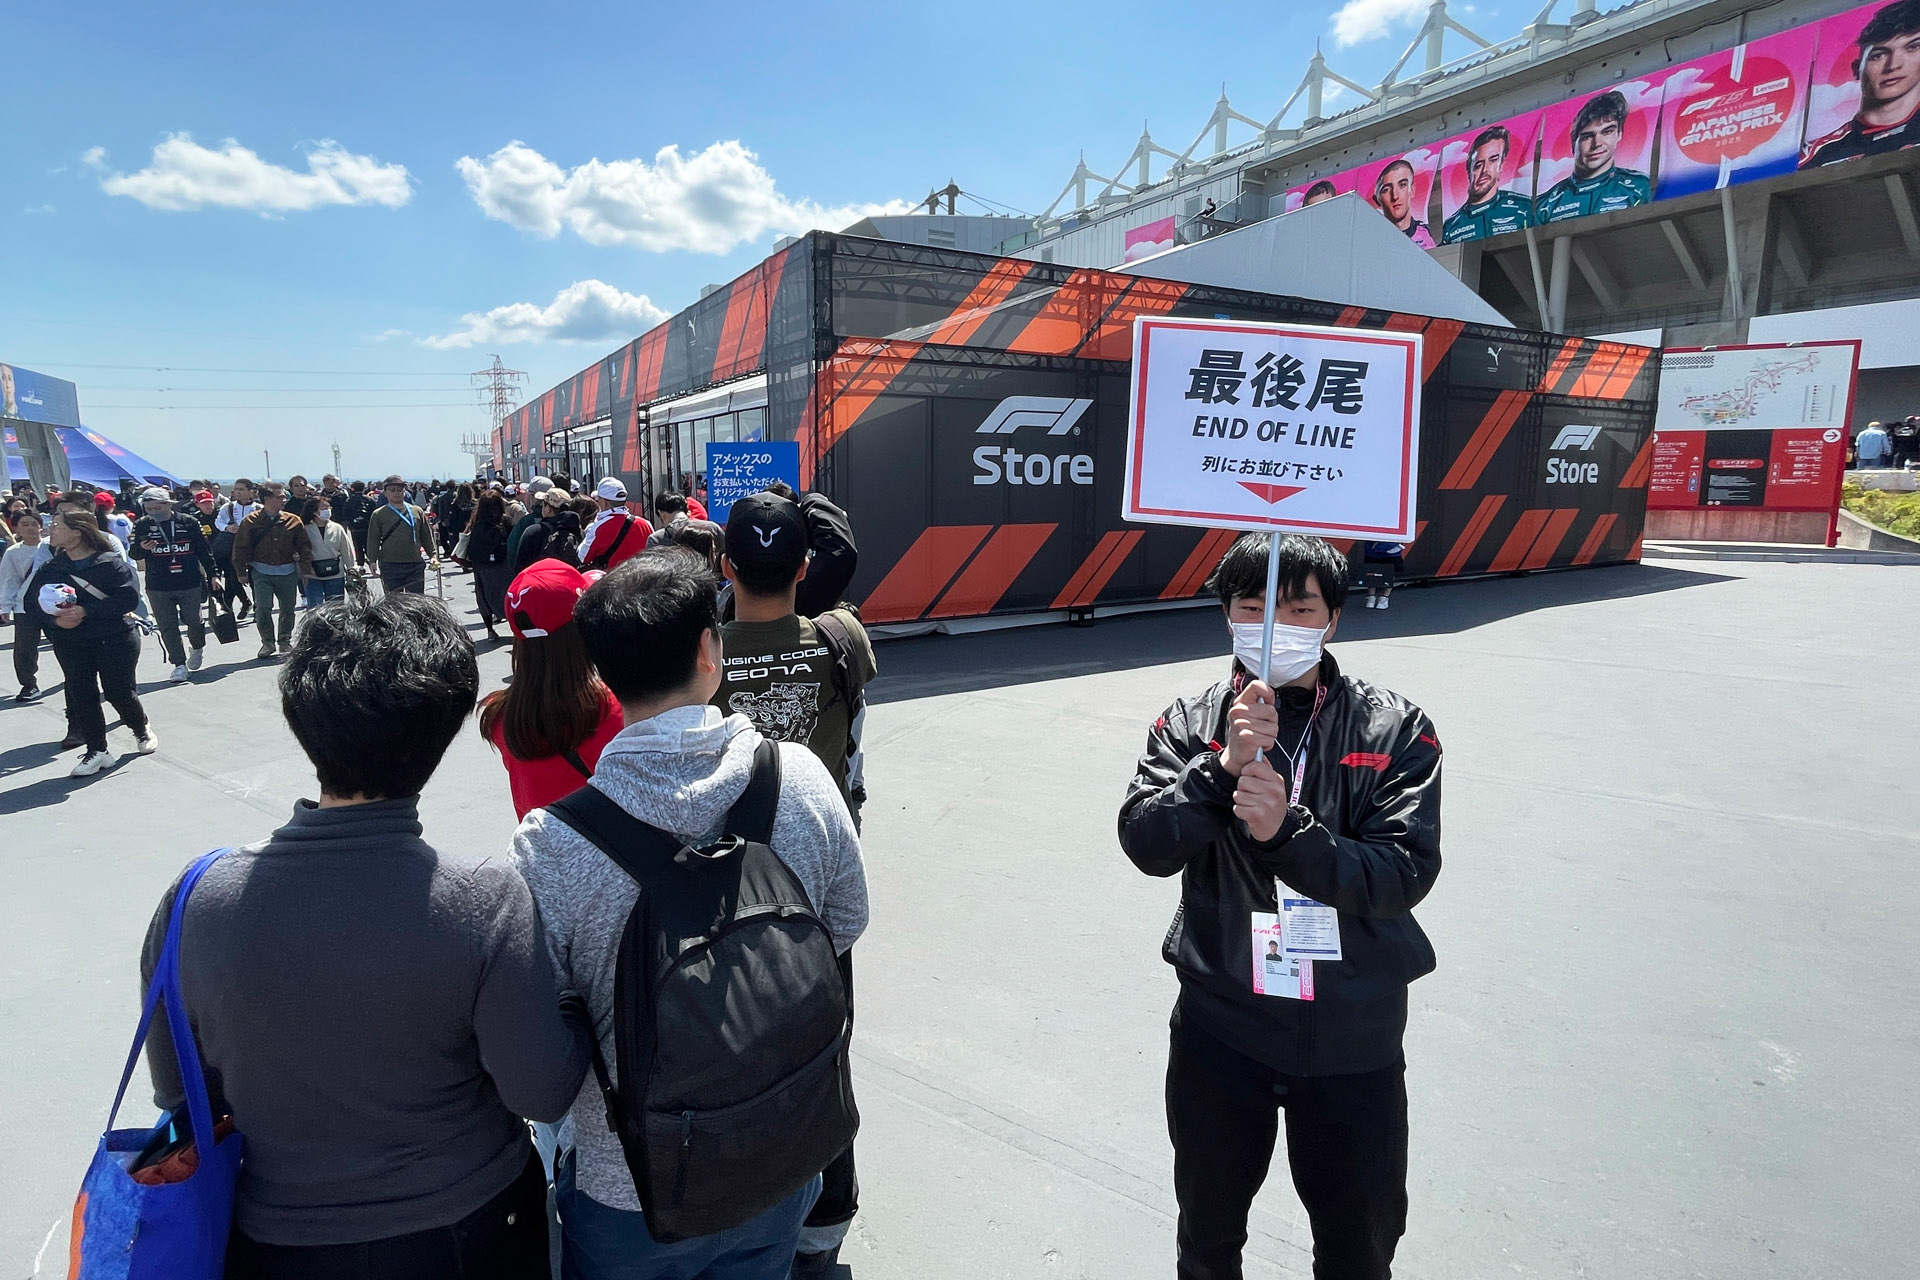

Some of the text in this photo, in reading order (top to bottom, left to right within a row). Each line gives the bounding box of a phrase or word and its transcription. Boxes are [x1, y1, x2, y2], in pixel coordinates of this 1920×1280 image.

[1680, 112, 1784, 147] GRAND PRIX
[1687, 103, 1776, 135] JAPANESE
[1184, 348, 1370, 415] 最後尾
[975, 395, 1094, 436] F1
[1192, 415, 1356, 449] END OF LINE
[1549, 424, 1602, 451] F1
[712, 453, 772, 465] アメックスの
[713, 465, 755, 477] カードで
[972, 445, 1094, 486] Store
[1202, 456, 1343, 481] 列にお並び下さい
[1546, 457, 1599, 484] Store
[713, 487, 764, 497] オリジナルタ
[172, 543, 190, 552] Bull
[721, 647, 829, 666] NGINE CODE
